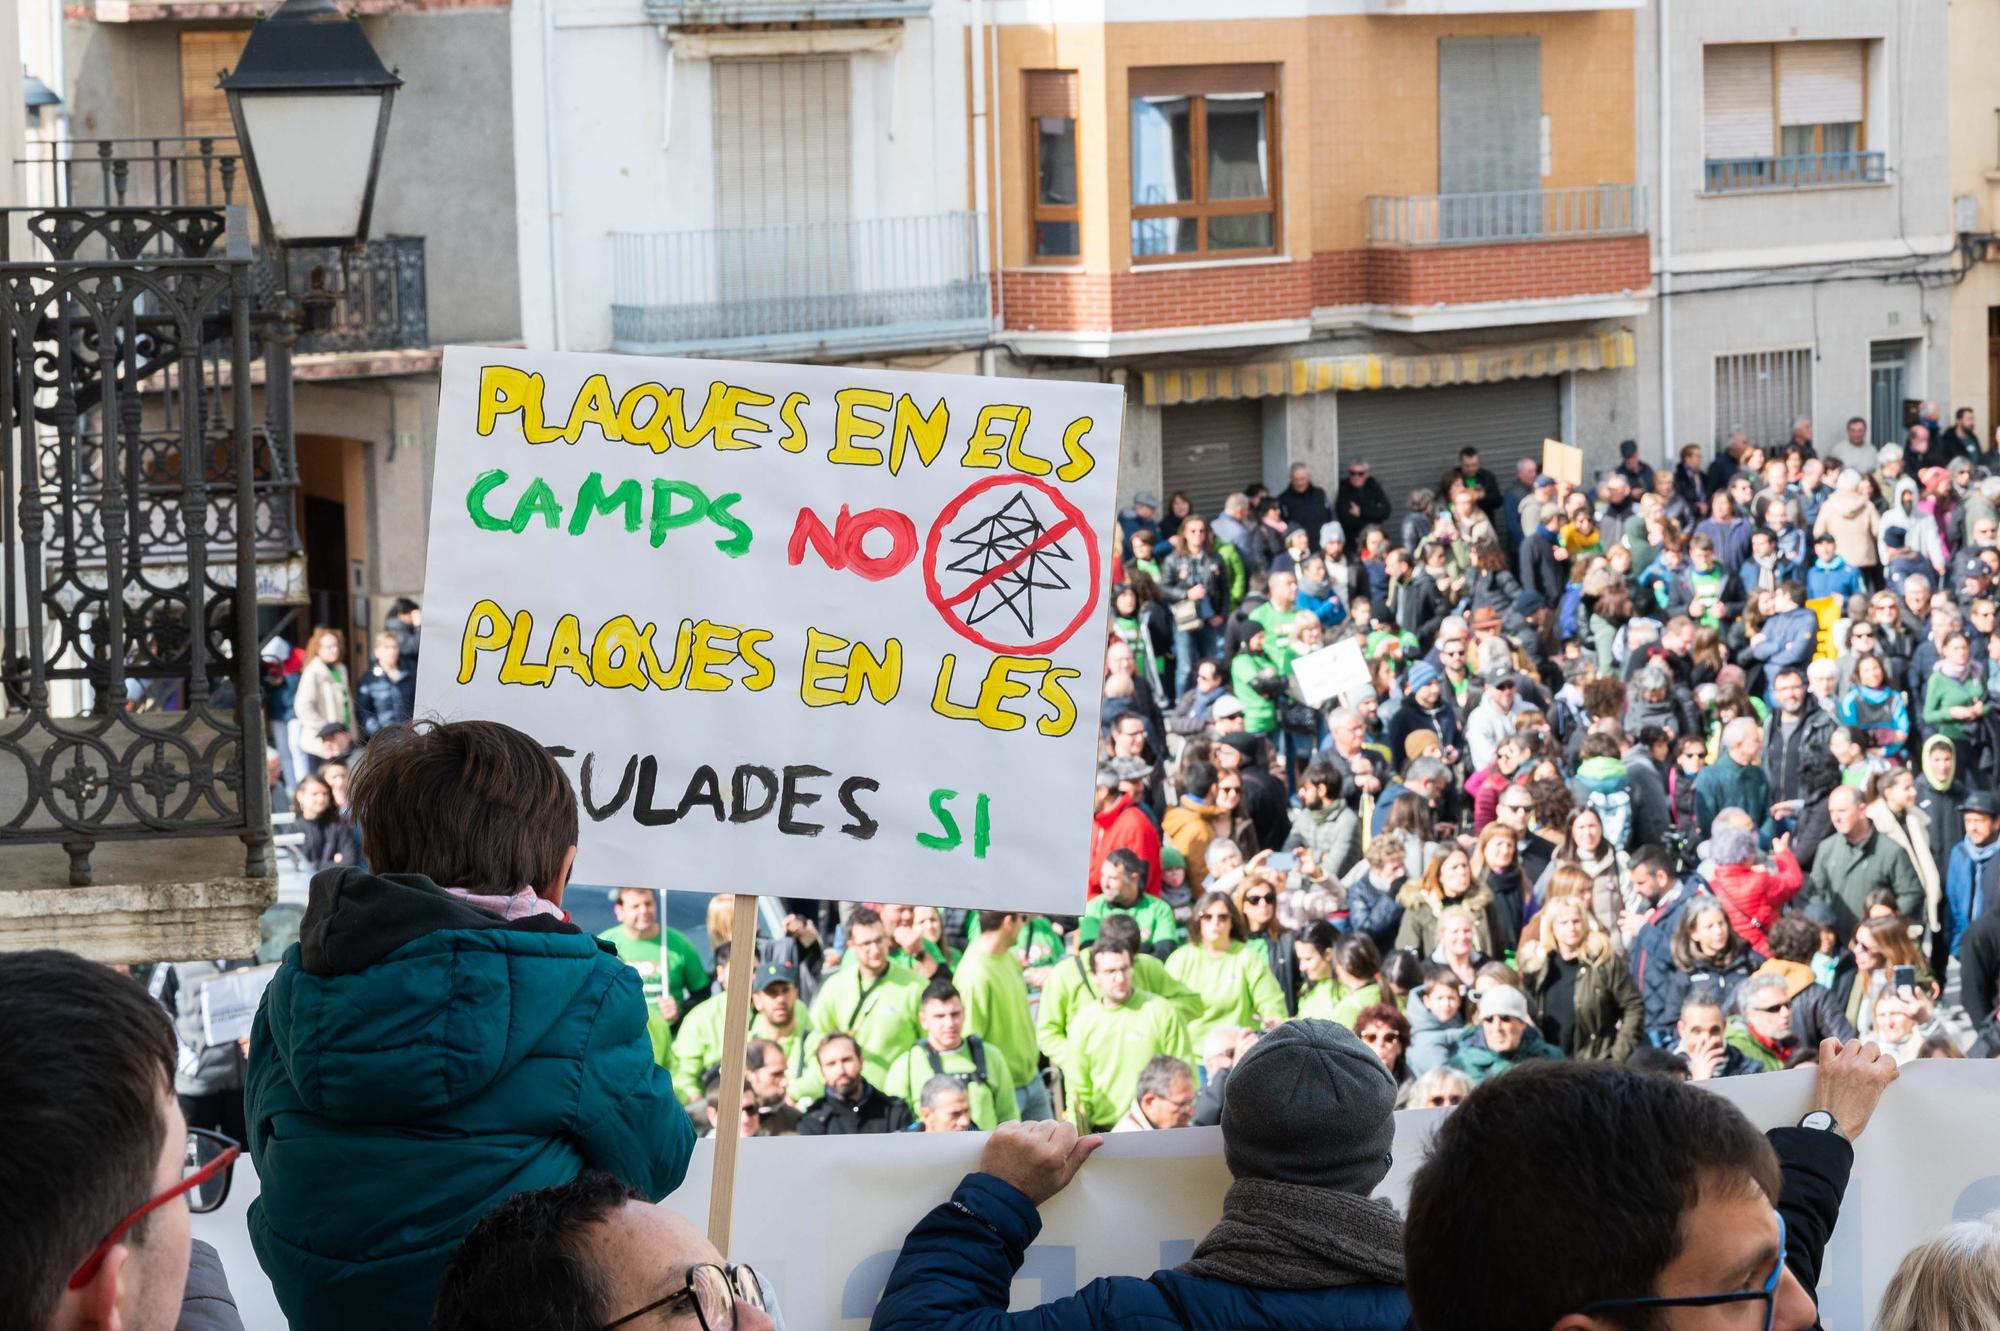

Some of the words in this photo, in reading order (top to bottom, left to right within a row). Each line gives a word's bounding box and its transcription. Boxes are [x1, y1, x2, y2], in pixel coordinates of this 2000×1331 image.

[476, 365, 810, 455] PLAQUES
[827, 388, 950, 477] EN
[961, 404, 1095, 482] ELS
[466, 469, 753, 558] CAMPS
[788, 503, 919, 581] NO
[457, 600, 775, 691] PLAQUES
[800, 627, 902, 707] EN
[930, 654, 1081, 738] LES
[543, 746, 879, 840] ULADES
[916, 789, 991, 859] SI
